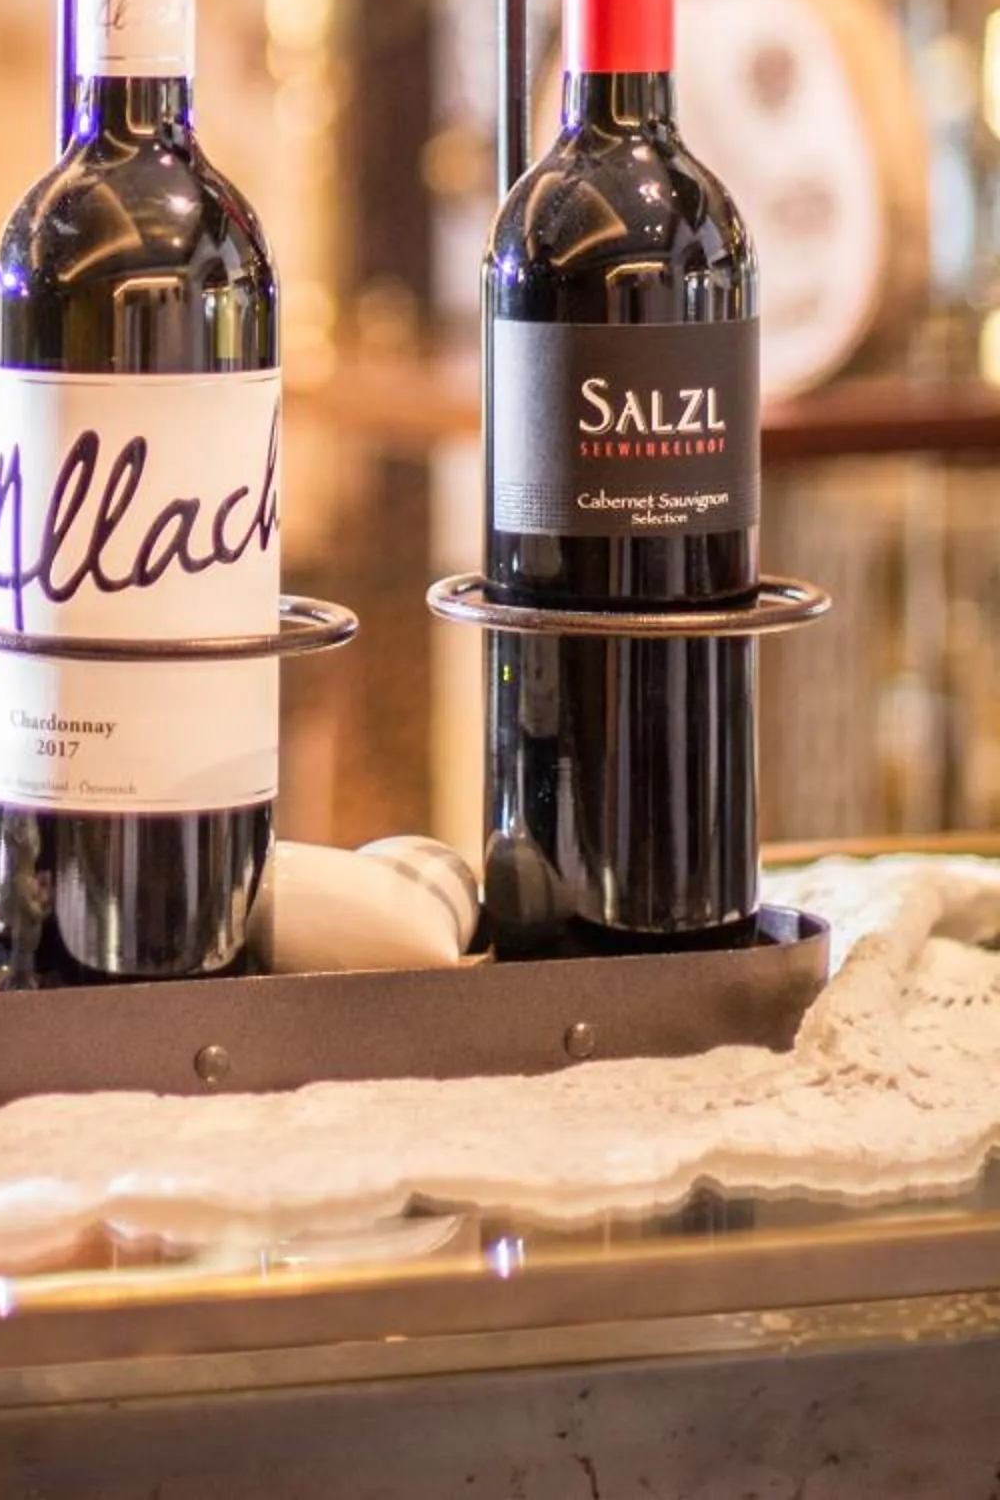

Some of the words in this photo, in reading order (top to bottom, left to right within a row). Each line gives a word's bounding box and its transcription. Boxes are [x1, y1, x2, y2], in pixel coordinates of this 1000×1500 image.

[579, 378, 726, 434] SALZL
[577, 489, 654, 509] Cabernet
[658, 490, 729, 513] Sauvignon
[631, 510, 689, 525] Selection
[9, 708, 117, 740] Chardonnay
[36, 739, 80, 759] 2017
